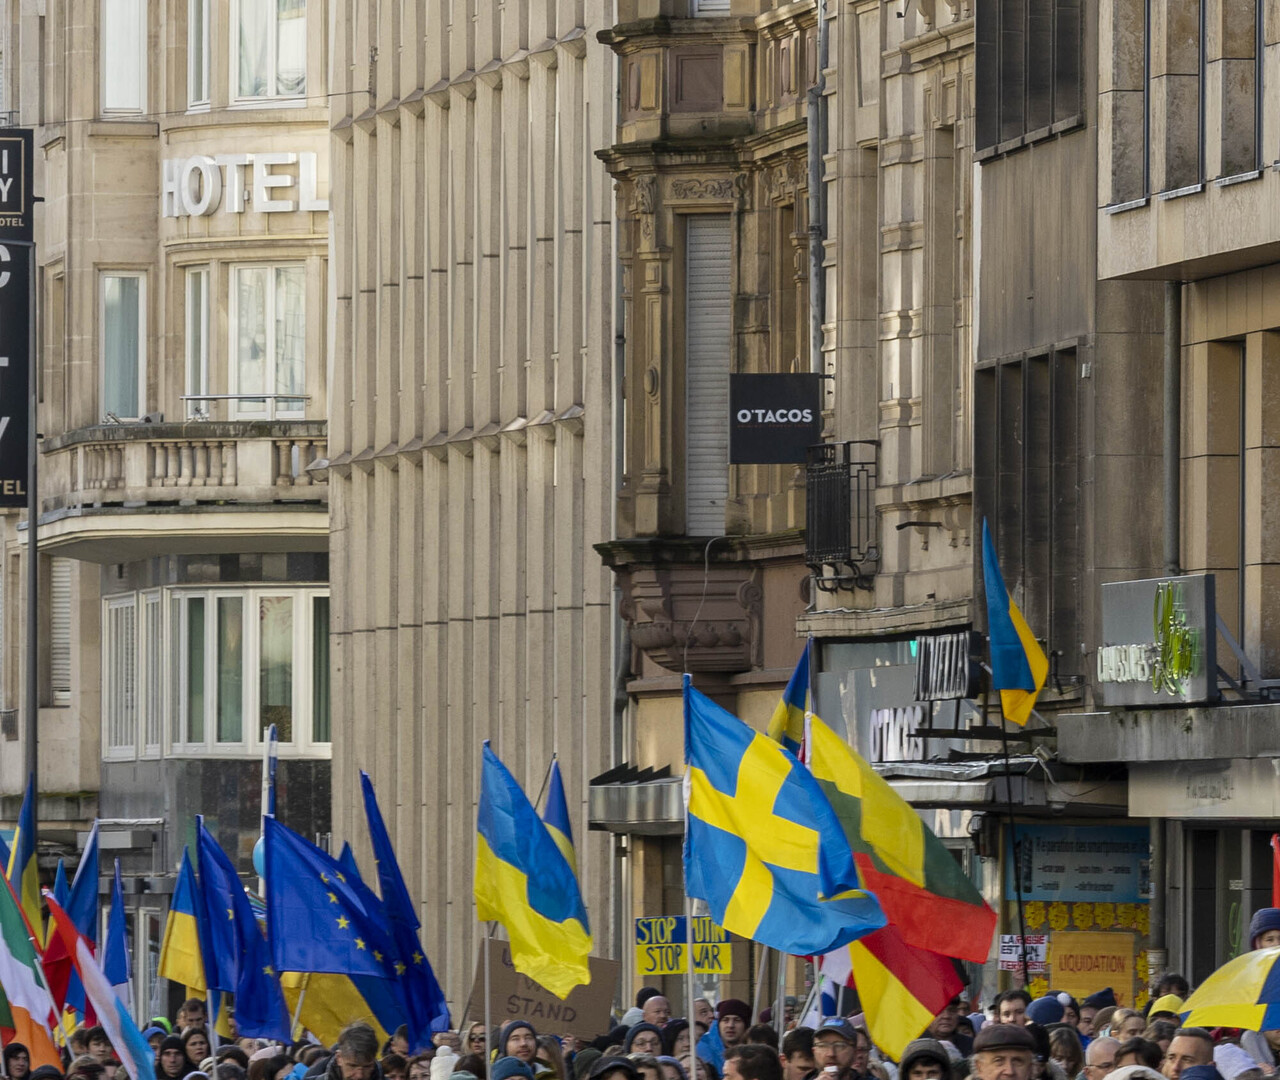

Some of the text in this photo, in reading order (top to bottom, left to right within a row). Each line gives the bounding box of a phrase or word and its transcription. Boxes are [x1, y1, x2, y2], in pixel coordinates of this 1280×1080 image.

[162, 151, 330, 218] HOTEL
[737, 408, 813, 424] O'TACOS
[637, 916, 726, 944] STOP UTIN
[645, 944, 682, 972] STOP
[1058, 953, 1128, 973] LIQUIDATION
[506, 994, 577, 1023] STAND
